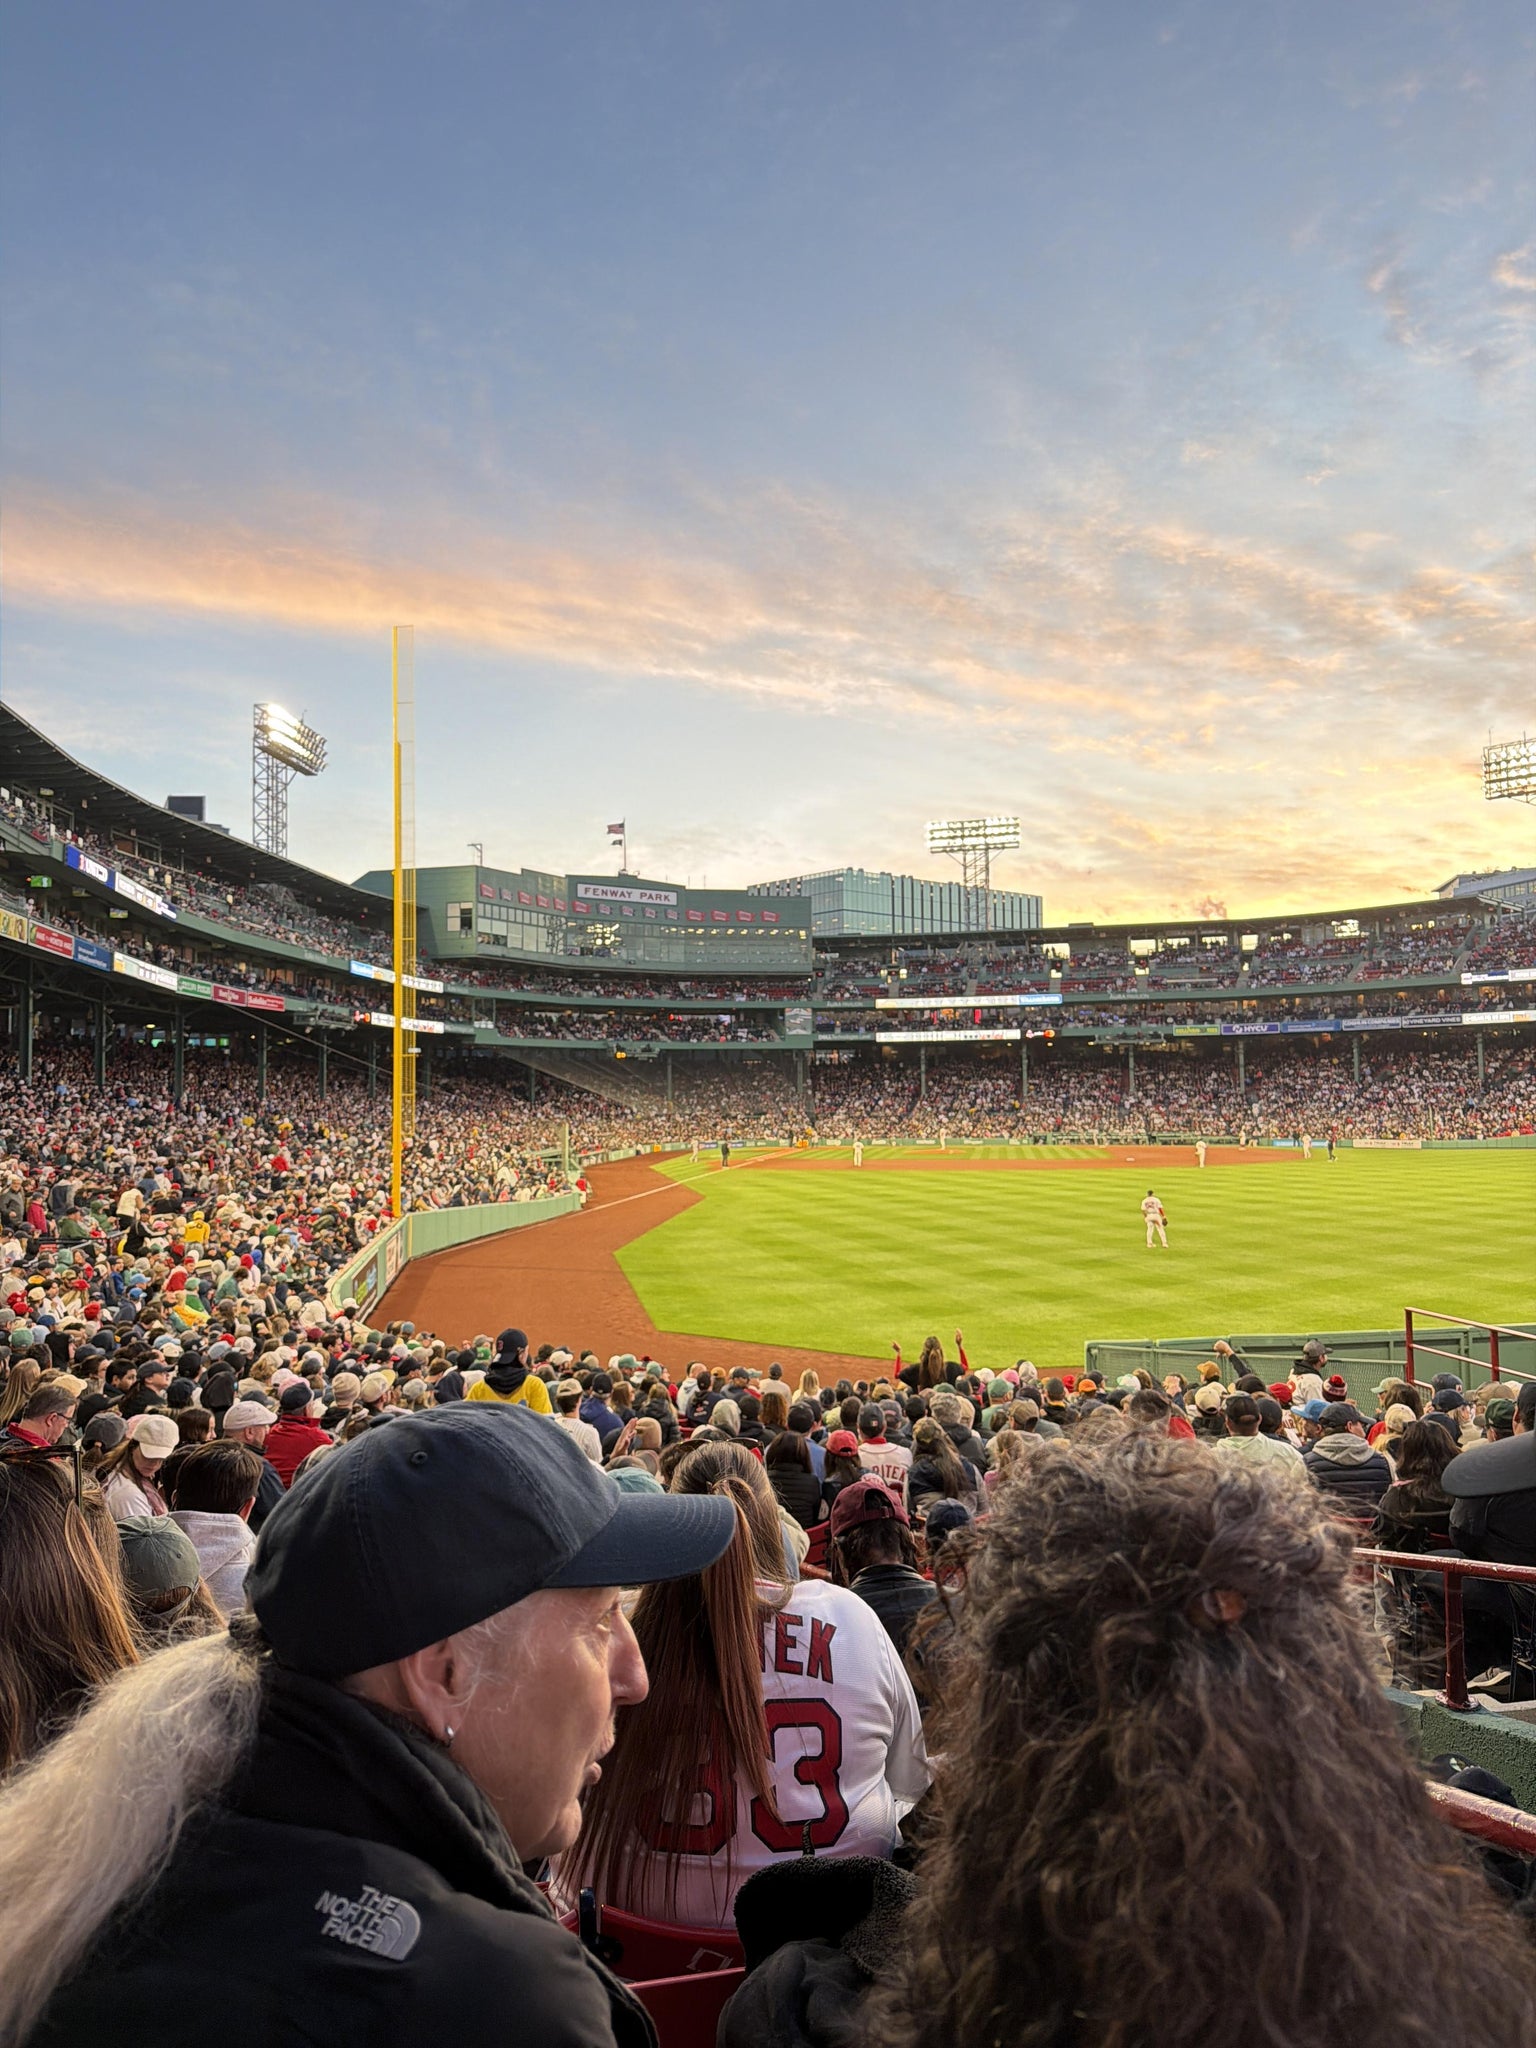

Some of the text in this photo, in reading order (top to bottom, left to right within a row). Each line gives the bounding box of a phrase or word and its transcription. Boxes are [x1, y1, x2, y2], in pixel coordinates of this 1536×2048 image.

[584, 887, 670, 902] FENWAY PARK
[1244, 1024, 1267, 1032] HYCU
[314, 1890, 386, 1933] NORTH
[358, 1884, 399, 1915] THE
[321, 1916, 376, 1950] FACE
